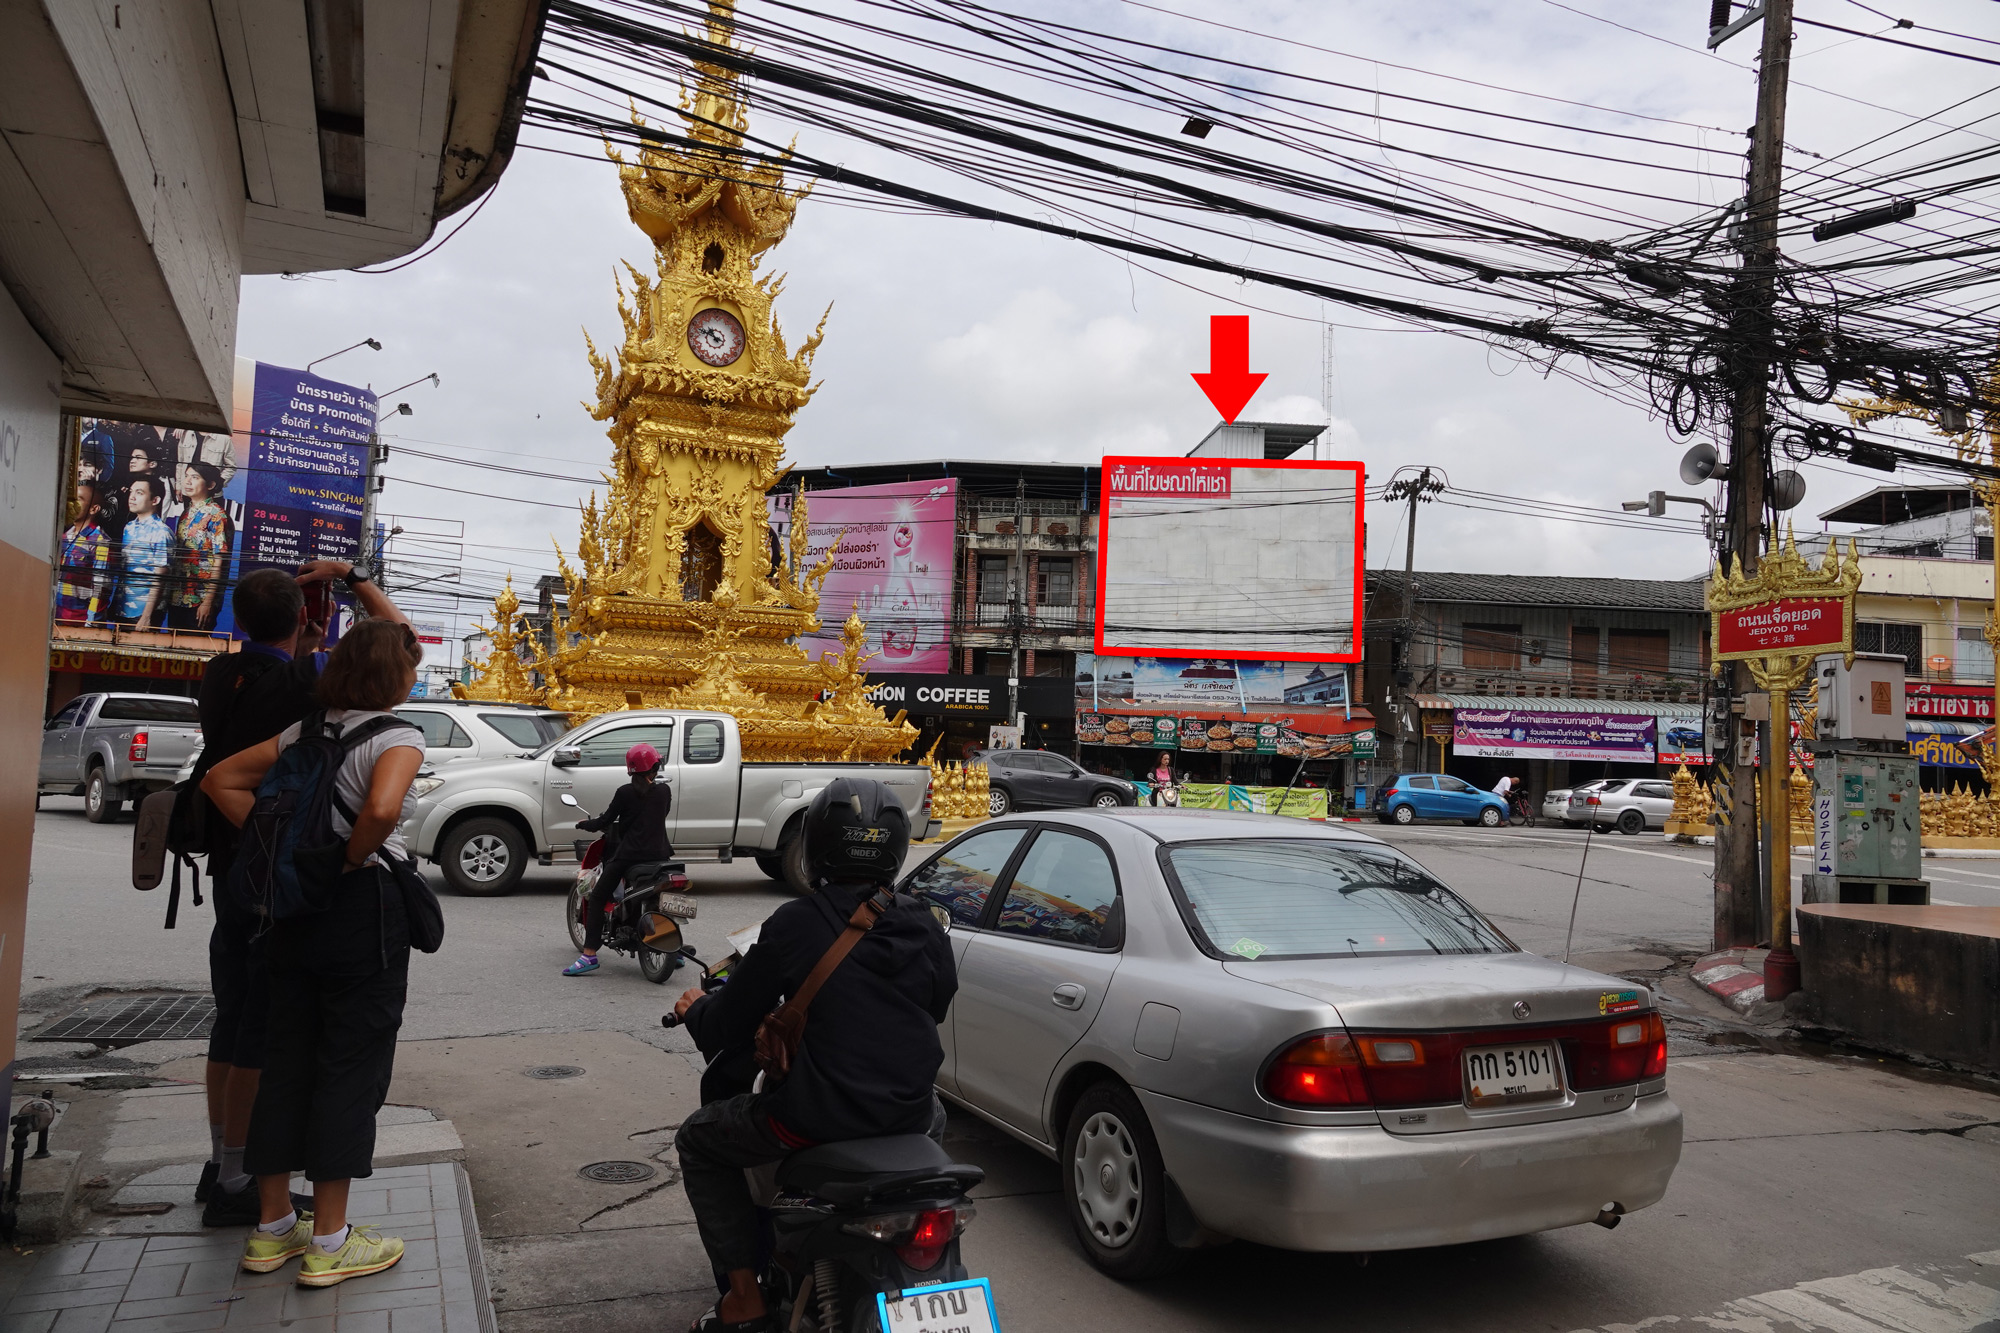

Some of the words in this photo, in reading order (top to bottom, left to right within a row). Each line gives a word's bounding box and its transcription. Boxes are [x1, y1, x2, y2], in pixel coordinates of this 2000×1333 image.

[297, 382, 355, 405] บัตรรายวัน
[290, 398, 314, 412] บัตร
[319, 404, 372, 427] Promotion
[281, 412, 310, 430] ซื้อได้ที่
[1110, 464, 1226, 492] พื้นที่โฆษณาให้เช่า
[254, 509, 266, 518] 28
[269, 512, 290, 522] พ.ย.
[260, 522, 274, 532] ว่าน
[312, 518, 324, 527] 29
[326, 522, 345, 531] พ.ย.
[318, 533, 334, 542] Jazz
[318, 544, 338, 553] Urboy
[1738, 606, 1822, 628] ถนนเจ็ดยอด
[1748, 626, 1788, 636] JEDYOD
[1794, 624, 1809, 632] Rd.
[916, 687, 990, 704] COFFEE
[1820, 800, 1830, 861] HOSTEL
[850, 848, 876, 857] INDEX
[1236, 941, 1262, 954] LPG
[1470, 1053, 1500, 1081] กก
[1505, 1048, 1550, 1077] 5101
[914, 1279, 942, 1288] HONDA
